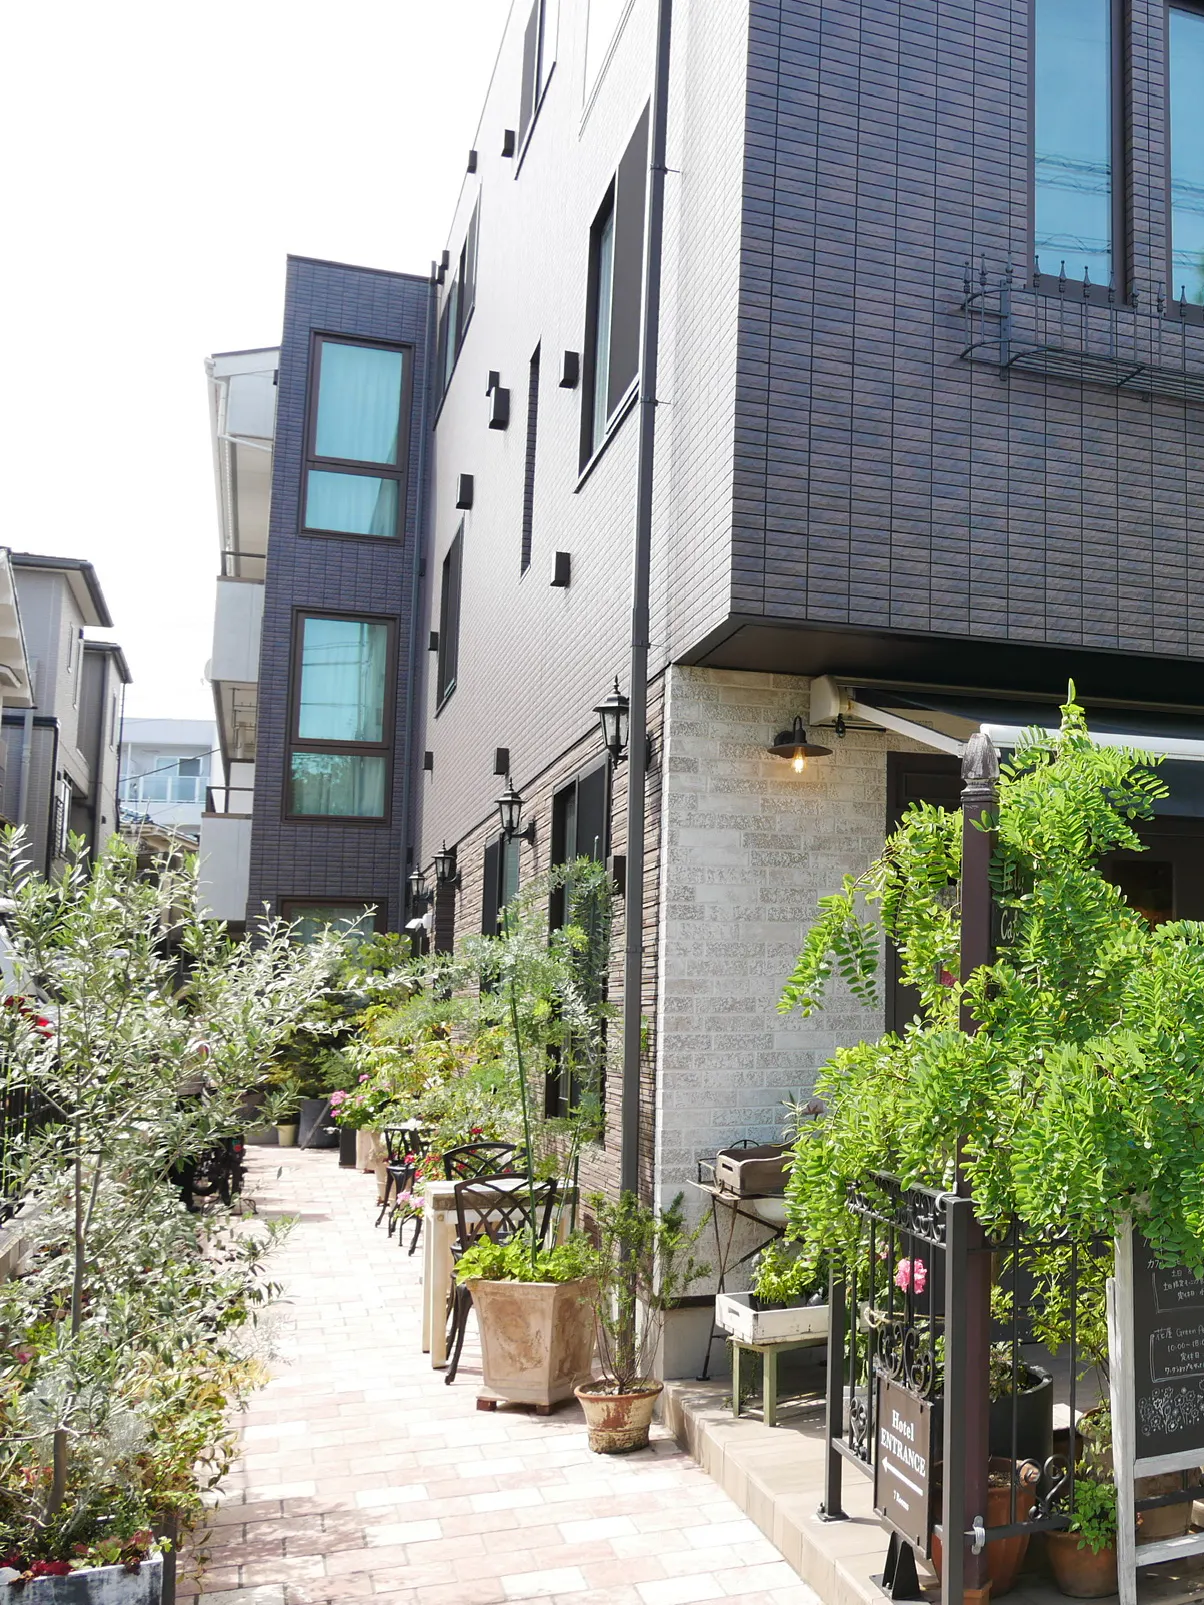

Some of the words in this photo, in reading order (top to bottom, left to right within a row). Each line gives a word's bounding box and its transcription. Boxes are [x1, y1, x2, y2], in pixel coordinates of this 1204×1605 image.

[1175, 1328, 1197, 1338] Green
[891, 1409, 915, 1442] Hotel
[880, 1427, 926, 1478] ENTRANCE
[896, 1492, 910, 1512] Rooms
